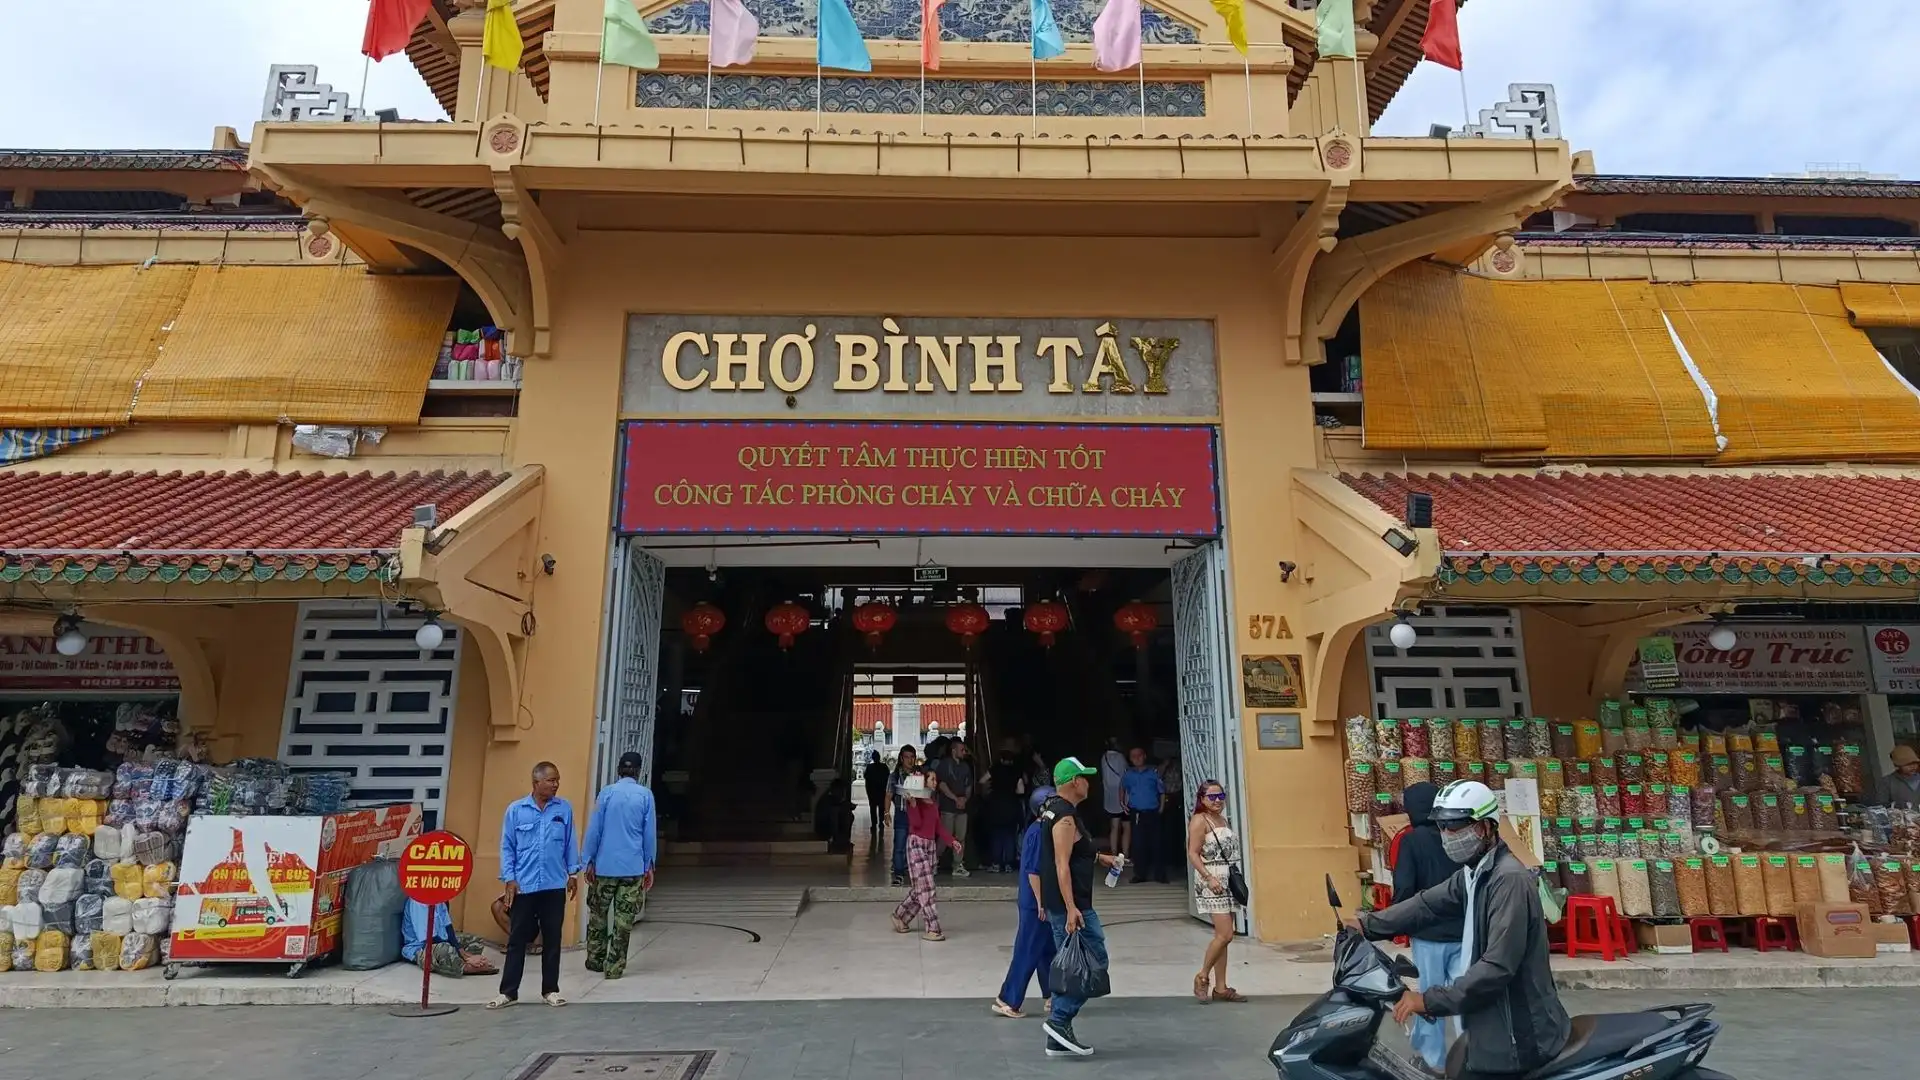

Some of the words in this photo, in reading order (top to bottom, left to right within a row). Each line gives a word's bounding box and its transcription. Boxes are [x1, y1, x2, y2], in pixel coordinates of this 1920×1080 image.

[660, 323, 817, 408] CHỢ
[833, 317, 1023, 393] BÌNH
[1035, 321, 1181, 394] TÂY
[737, 440, 831, 472] QUYẾT
[836, 441, 898, 468] TÂM
[903, 446, 978, 472] THỰC
[983, 445, 1049, 472] HIỆN
[1053, 443, 1107, 470] TỐT
[653, 478, 734, 506] CÔNG
[739, 478, 795, 506] TÁC
[800, 478, 896, 506] PHÒNG
[901, 479, 978, 507] CHÁY
[983, 479, 1024, 507] VÀ
[1027, 480, 1107, 508] CHỮA
[1110, 481, 1187, 509] CHÁY
[1249, 614, 1294, 640] 57A
[1767, 641, 1854, 664] Trúc
[1882, 640, 1906, 652] 16
[409, 839, 465, 860] CẤM
[286, 869, 310, 880] BUS
[405, 876, 418, 889] XE
[421, 873, 440, 889] VÀO
[441, 875, 462, 892] CHỢ
